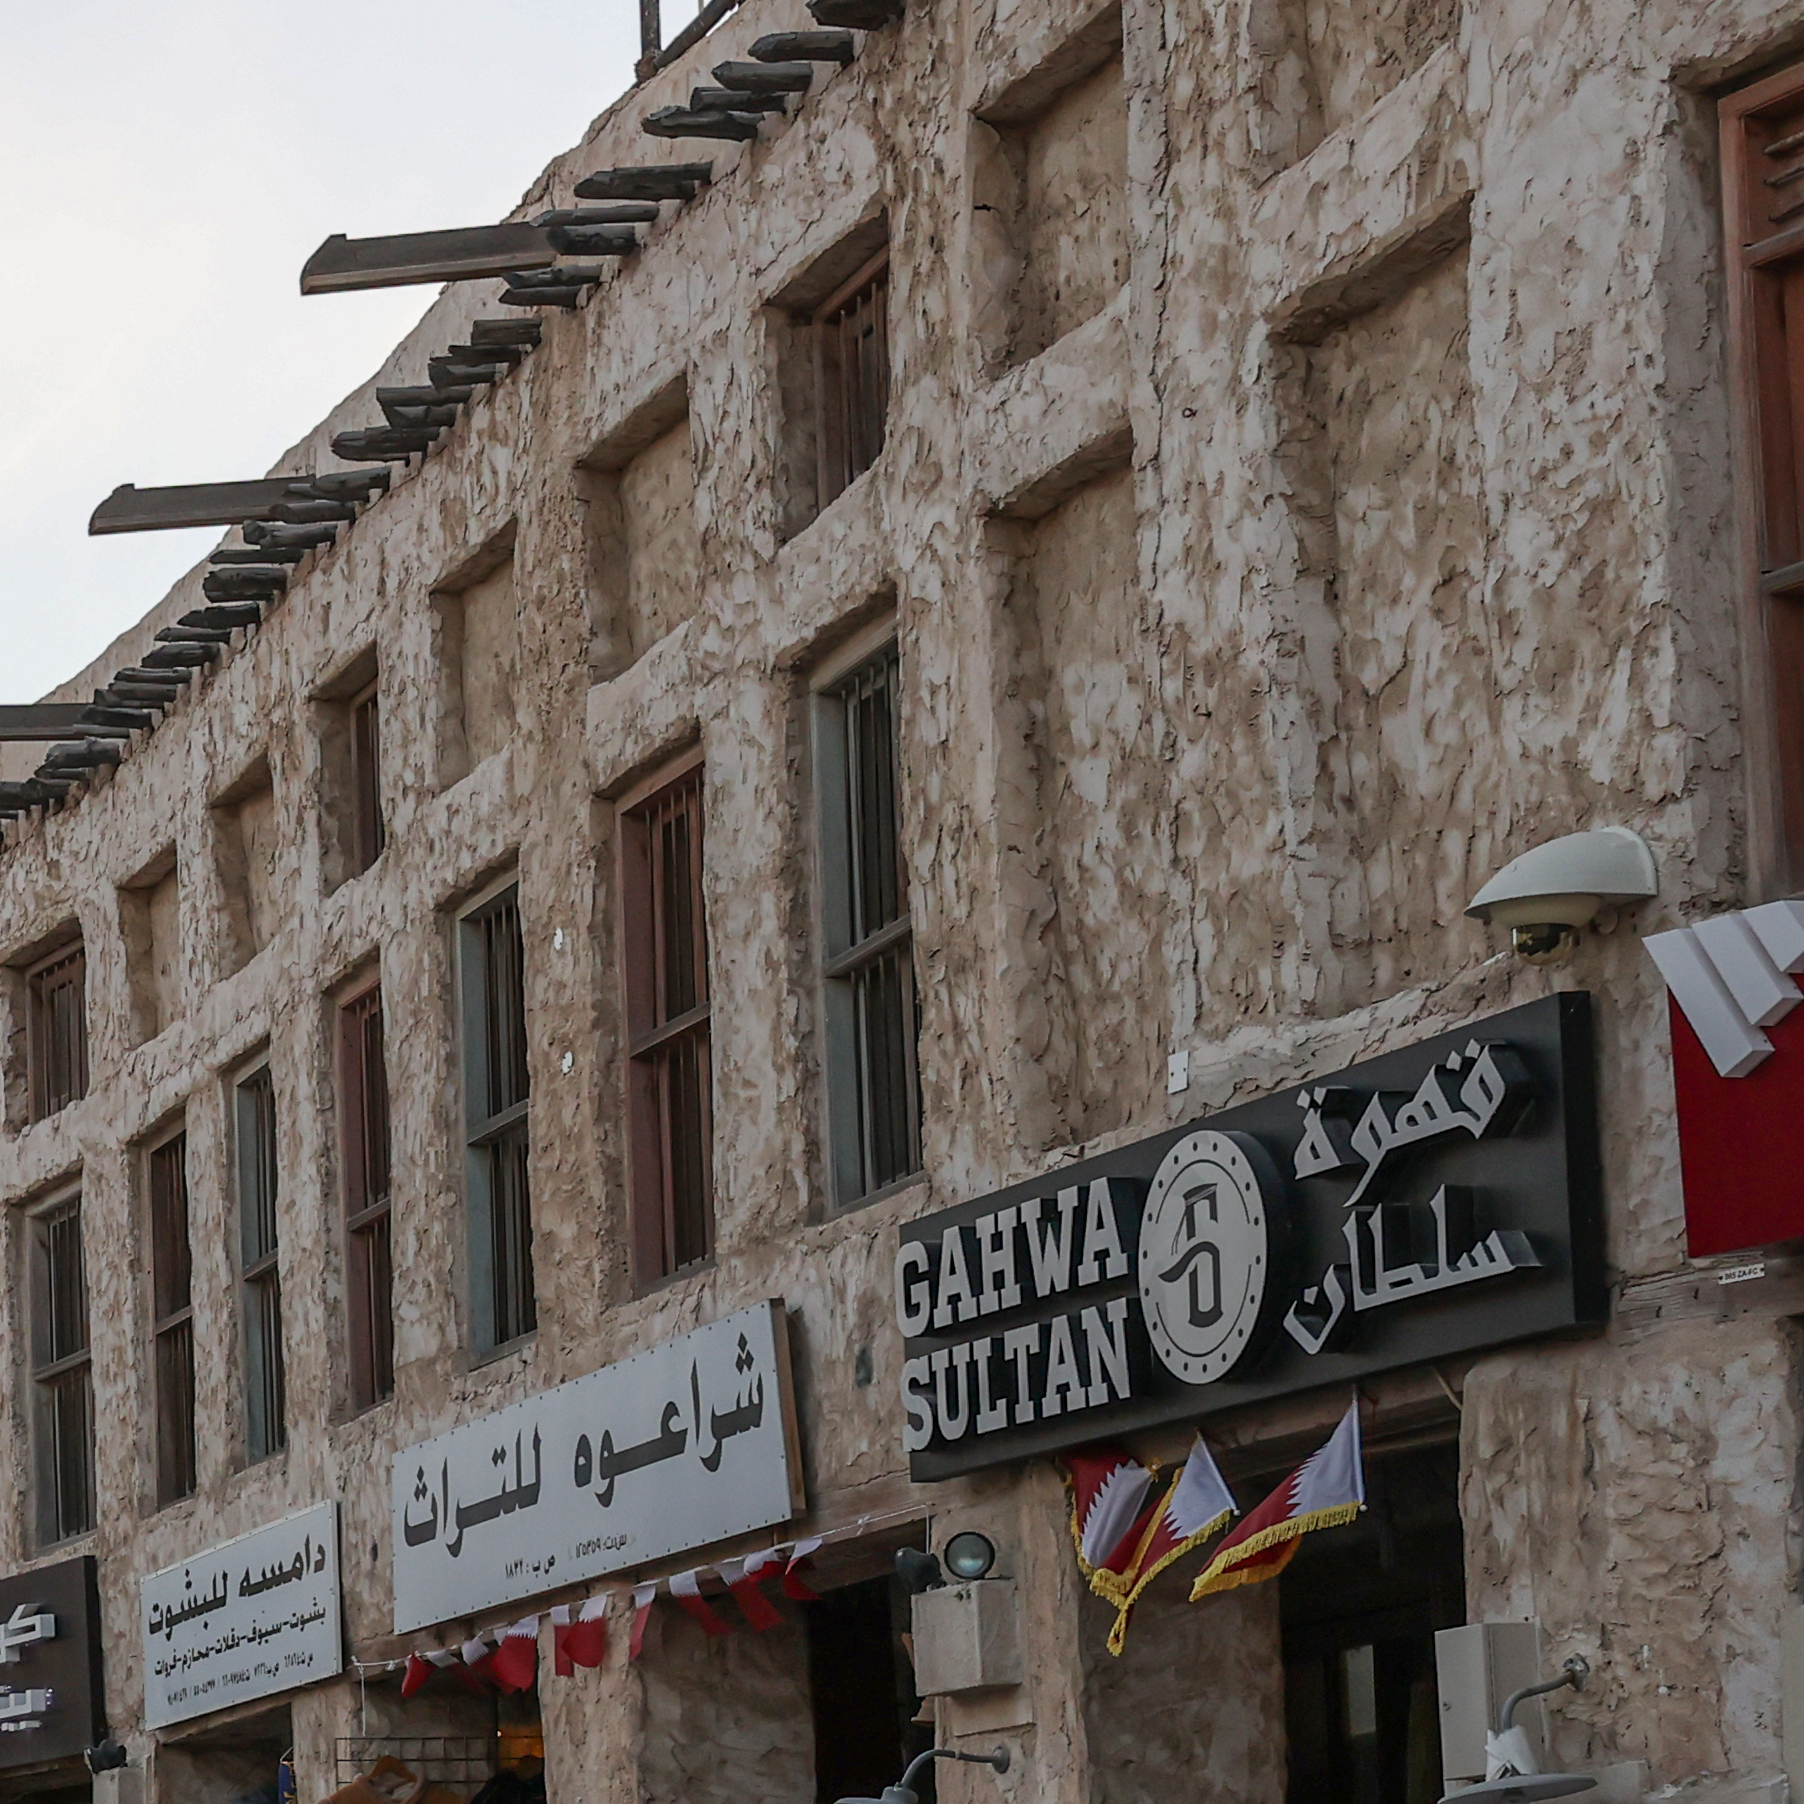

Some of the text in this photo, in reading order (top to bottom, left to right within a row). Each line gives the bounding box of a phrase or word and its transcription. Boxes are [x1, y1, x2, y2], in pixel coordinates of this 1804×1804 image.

[1293, 1038, 1506, 1208] قهوة
[894, 1175, 1128, 1338] GAHWA
[1282, 1183, 1517, 1355] سلطان
[902, 1297, 1132, 1453] SULTAN
[403, 1421, 542, 1559] للتراث
[148, 1567, 229, 1642] للبشوت
